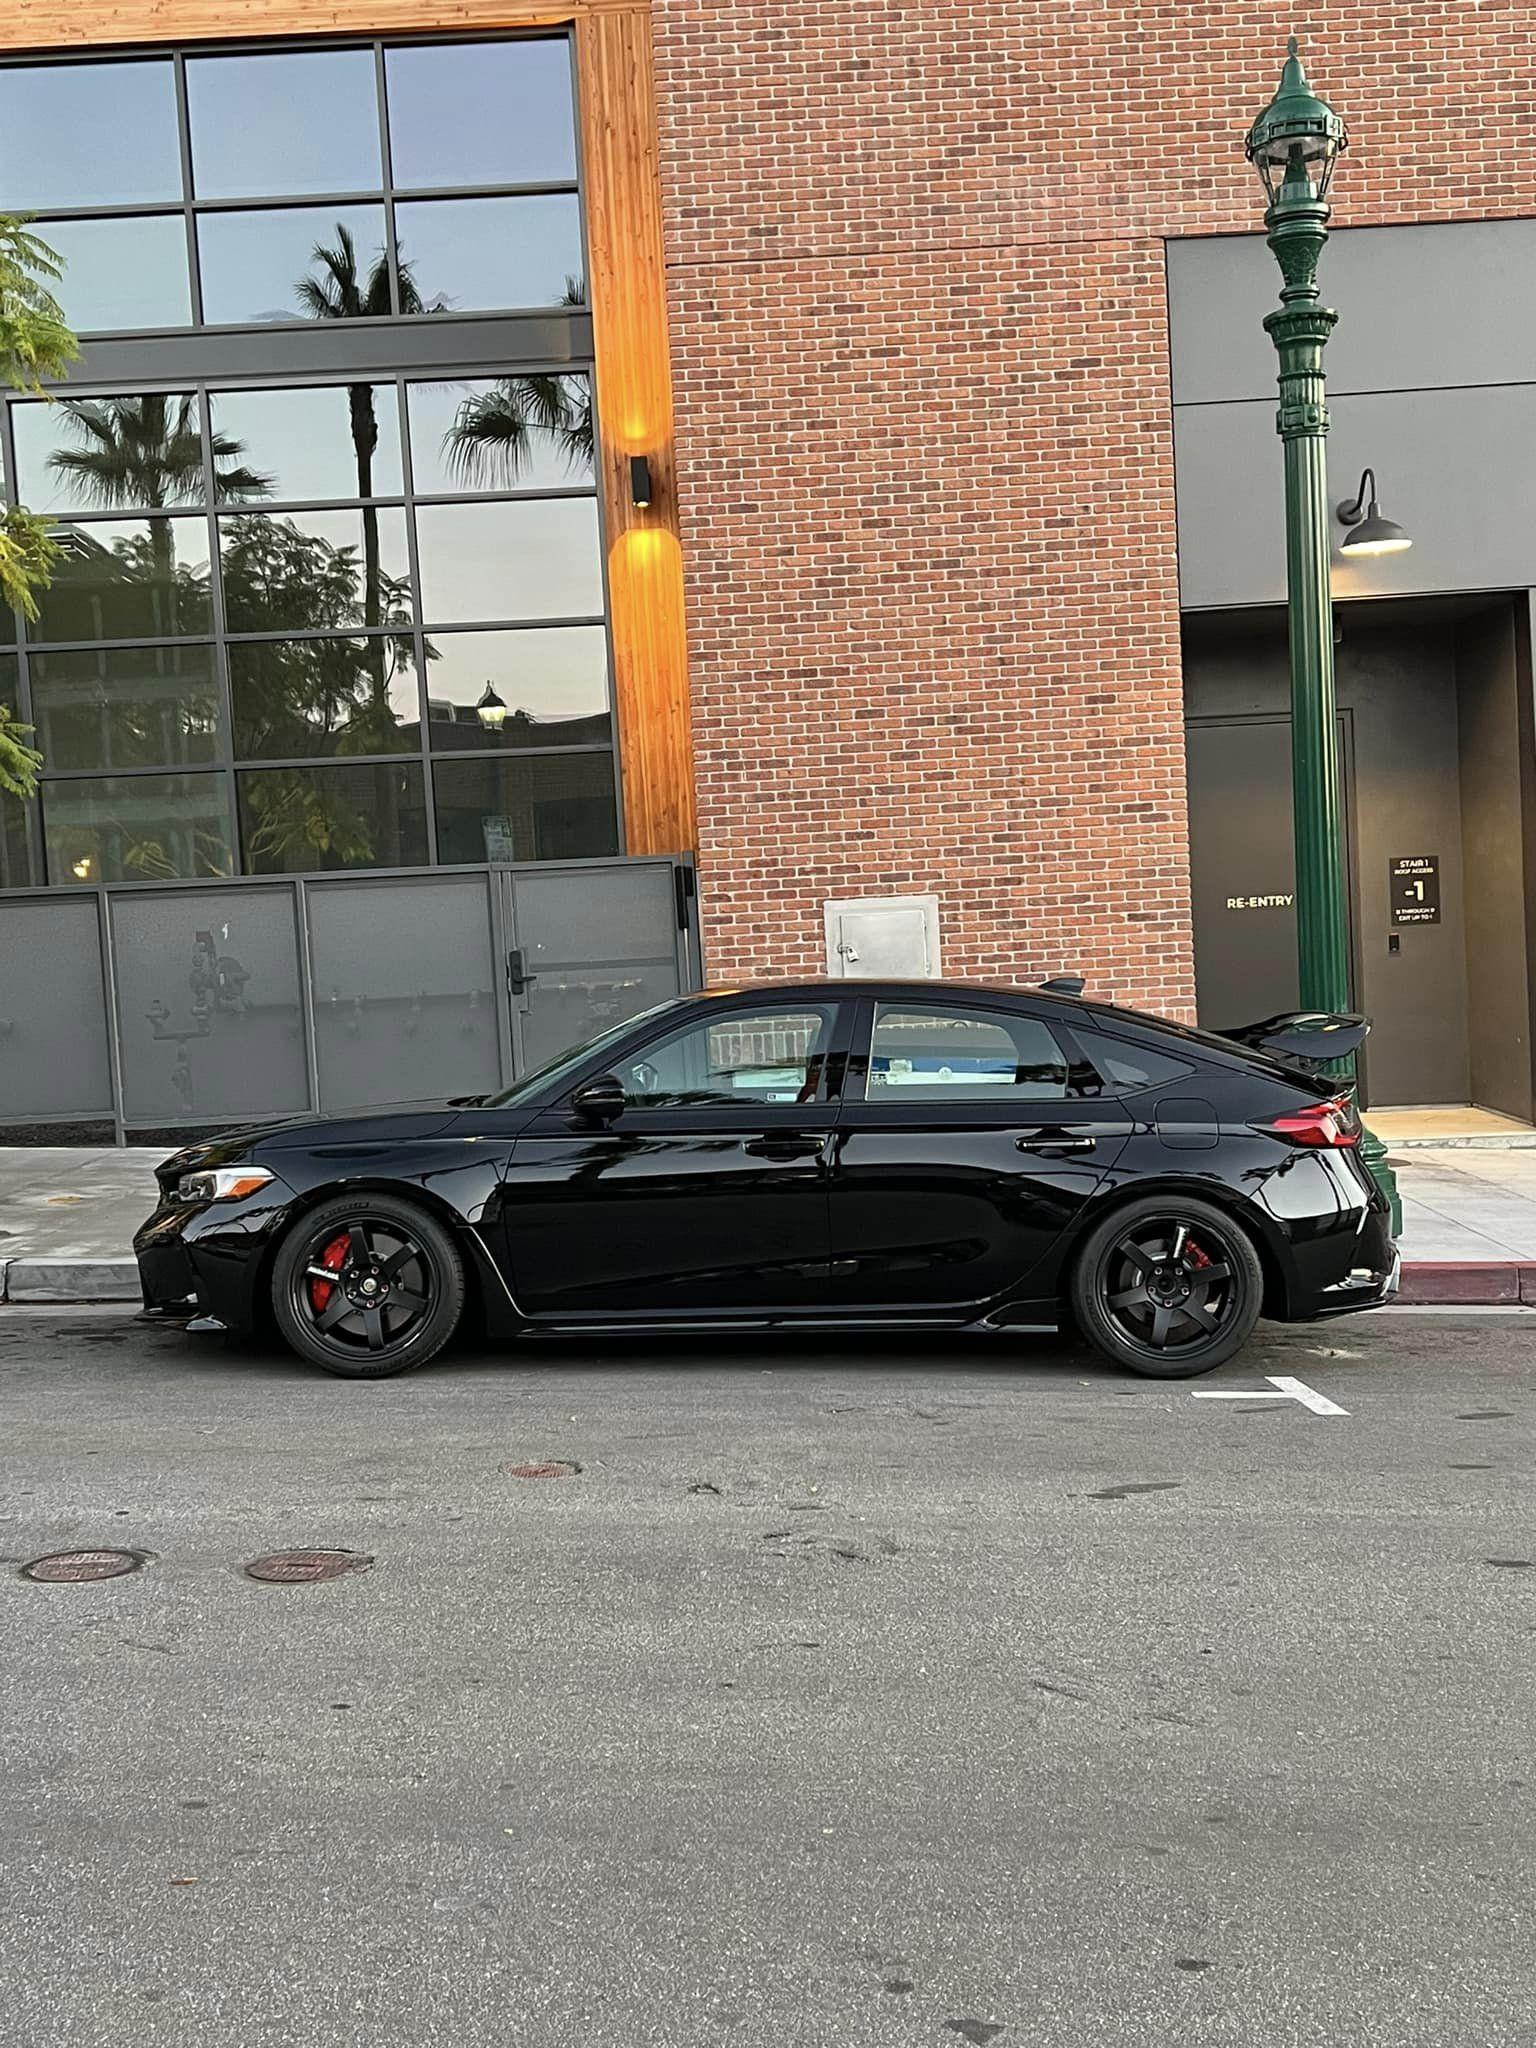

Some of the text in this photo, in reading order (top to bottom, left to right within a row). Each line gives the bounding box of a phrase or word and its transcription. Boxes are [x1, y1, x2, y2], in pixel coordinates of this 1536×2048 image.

[1400, 860, 1424, 868] STAIR
[1404, 880, 1424, 901] -1
[1227, 895, 1293, 909] RE-ENTRY
